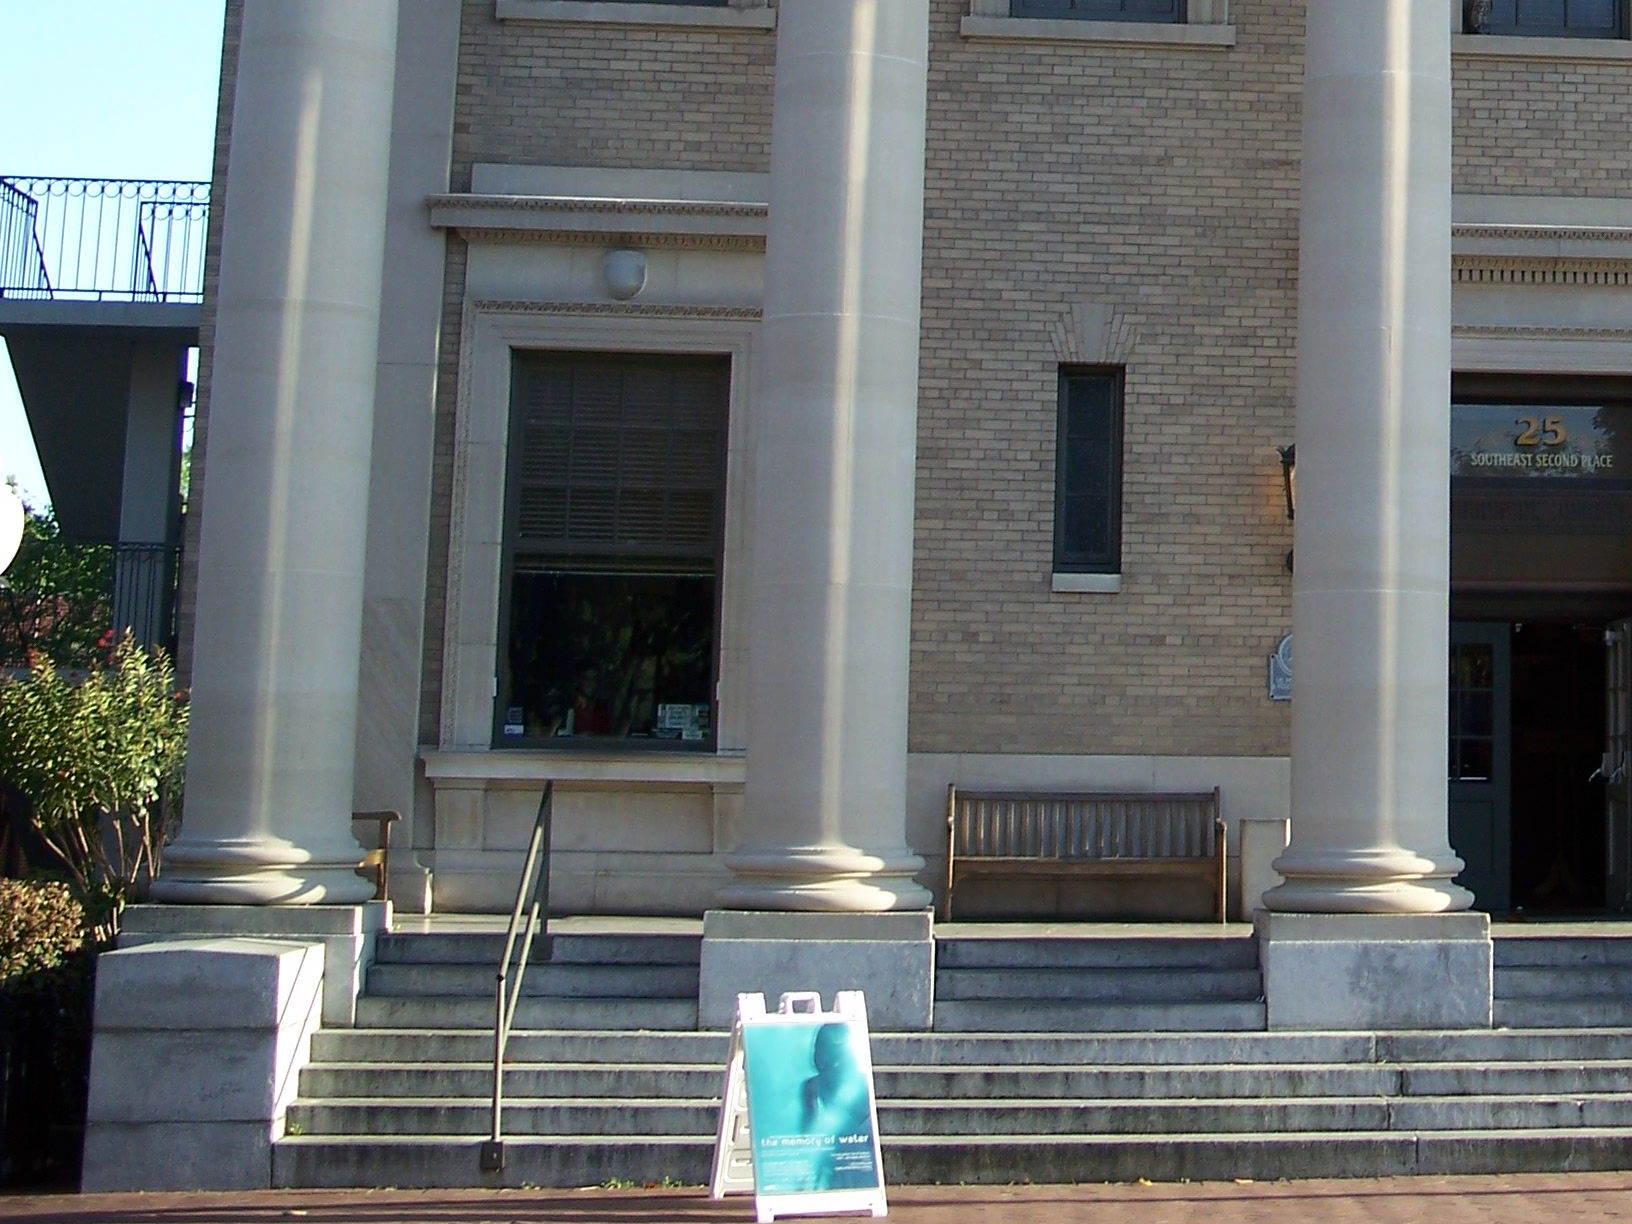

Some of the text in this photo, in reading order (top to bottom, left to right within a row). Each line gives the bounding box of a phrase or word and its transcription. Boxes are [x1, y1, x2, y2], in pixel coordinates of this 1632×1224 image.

[1514, 415, 1566, 446] 25
[1471, 453, 1613, 468] SOUTHEAST SECOND PLACE
[761, 1133, 869, 1147] the memory of water
